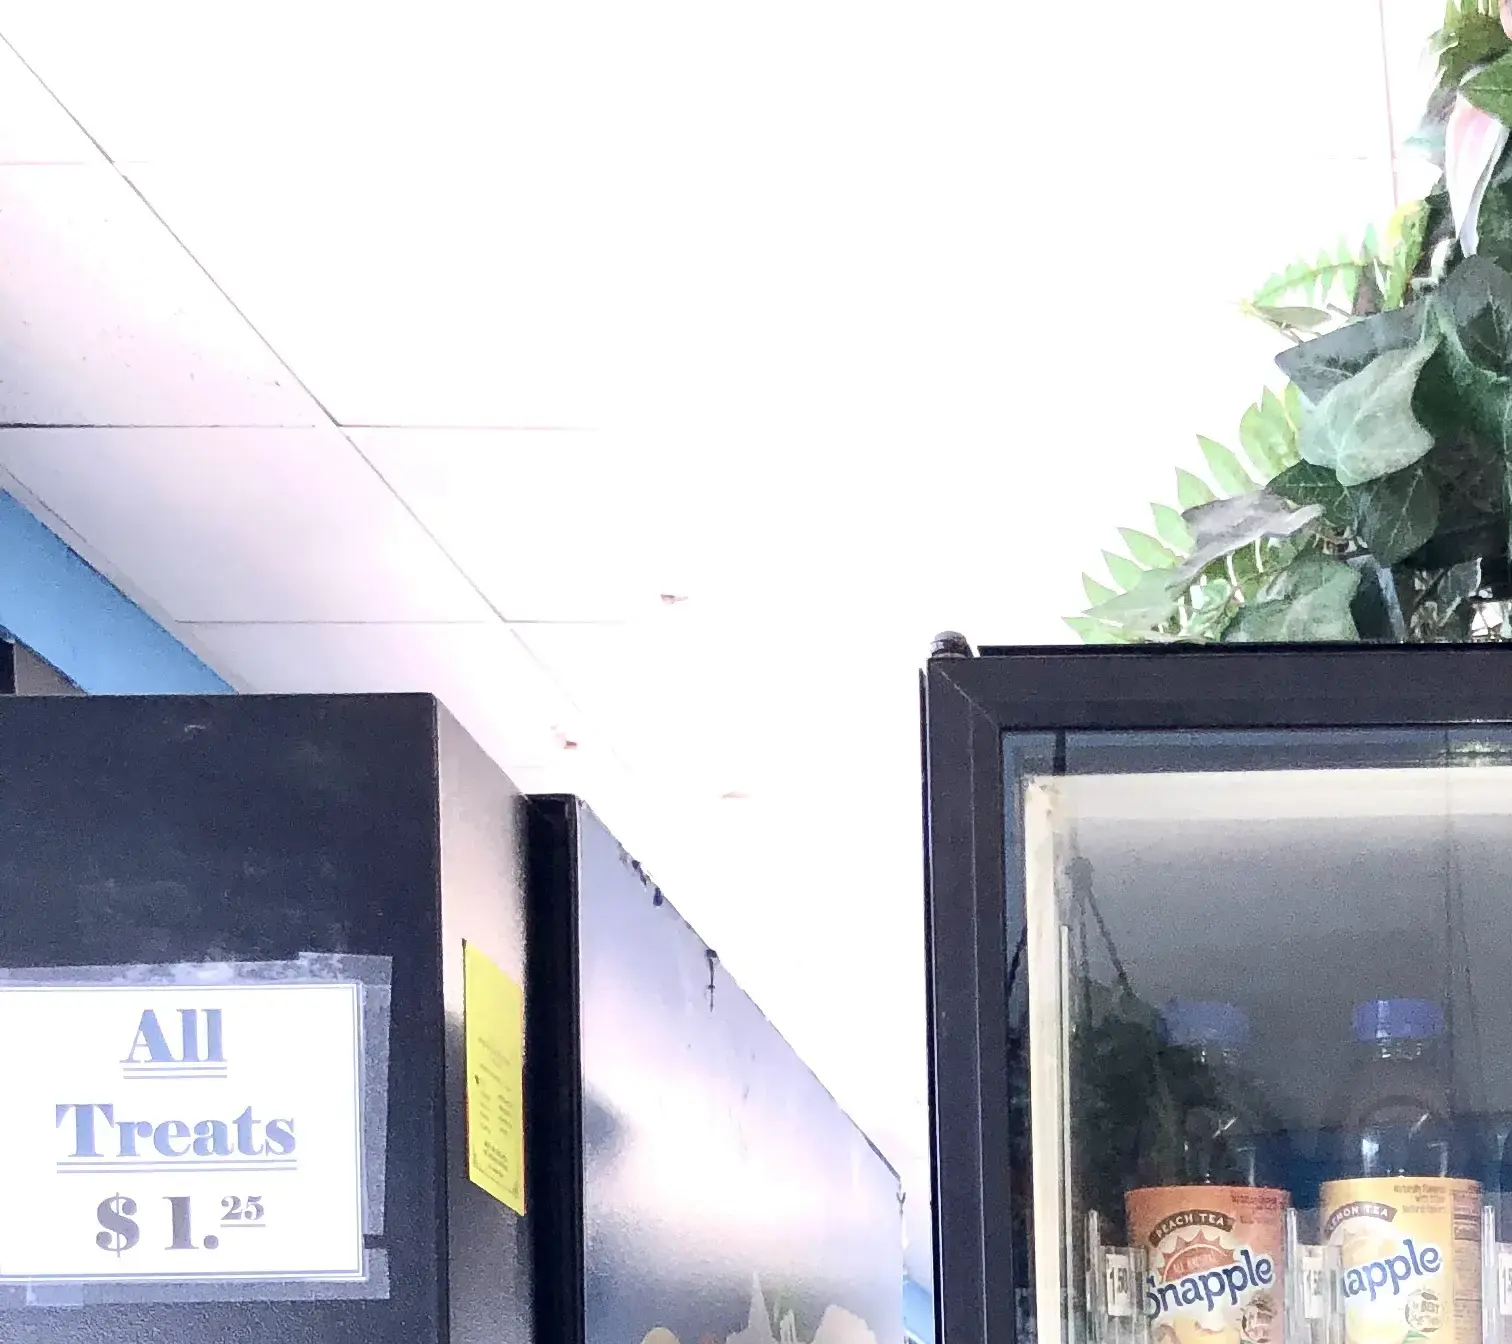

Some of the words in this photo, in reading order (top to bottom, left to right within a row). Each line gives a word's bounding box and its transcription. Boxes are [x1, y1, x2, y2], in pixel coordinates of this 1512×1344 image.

[120, 1008, 228, 1064] All
[55, 1103, 297, 1158] Treats
[1157, 1212, 1194, 1238] PEACH
[1199, 1212, 1226, 1225] TEA
[1364, 1204, 1389, 1217] TEA
[1142, 1249, 1275, 1321] Snapple
